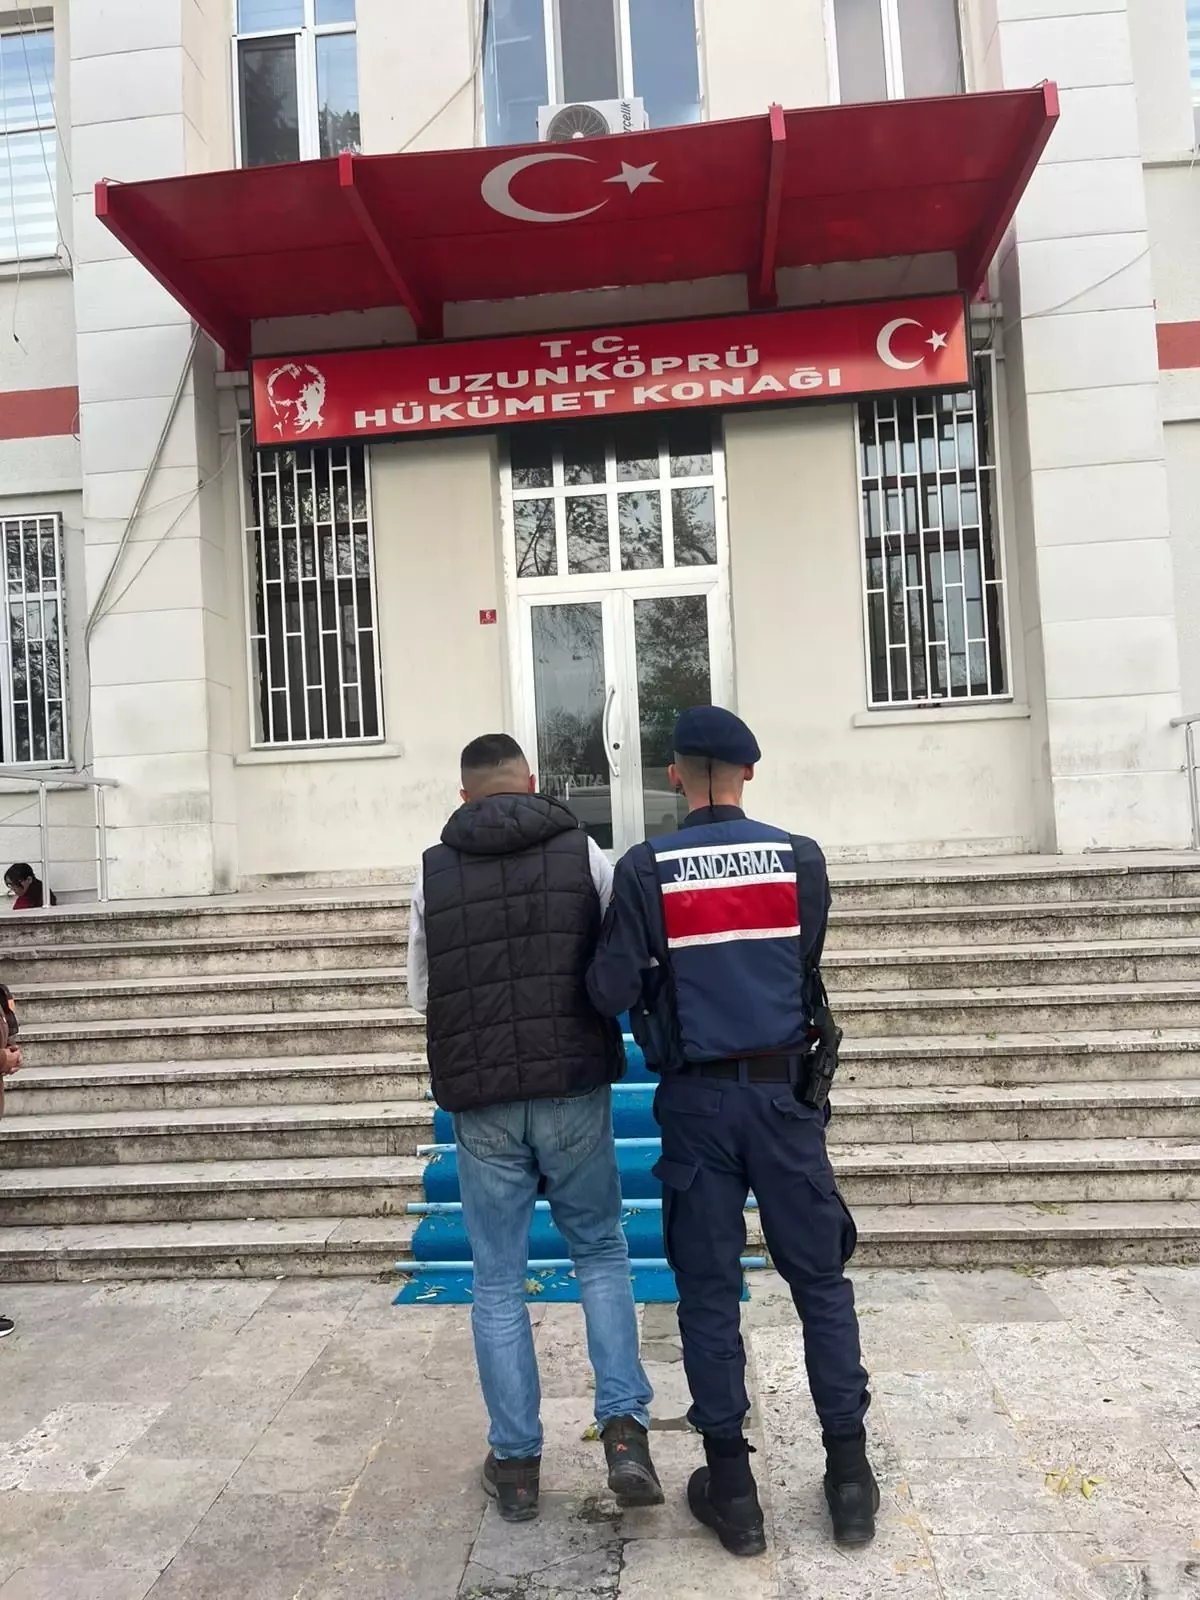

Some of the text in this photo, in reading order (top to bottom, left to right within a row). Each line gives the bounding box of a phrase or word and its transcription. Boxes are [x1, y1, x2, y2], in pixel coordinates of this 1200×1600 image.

[540, 336, 640, 358] T.C.
[428, 344, 759, 395] UZUNKÖPRÜ
[354, 366, 841, 429] HÜKÜMET KONAĞI
[673, 850, 785, 882] JANDARMA
